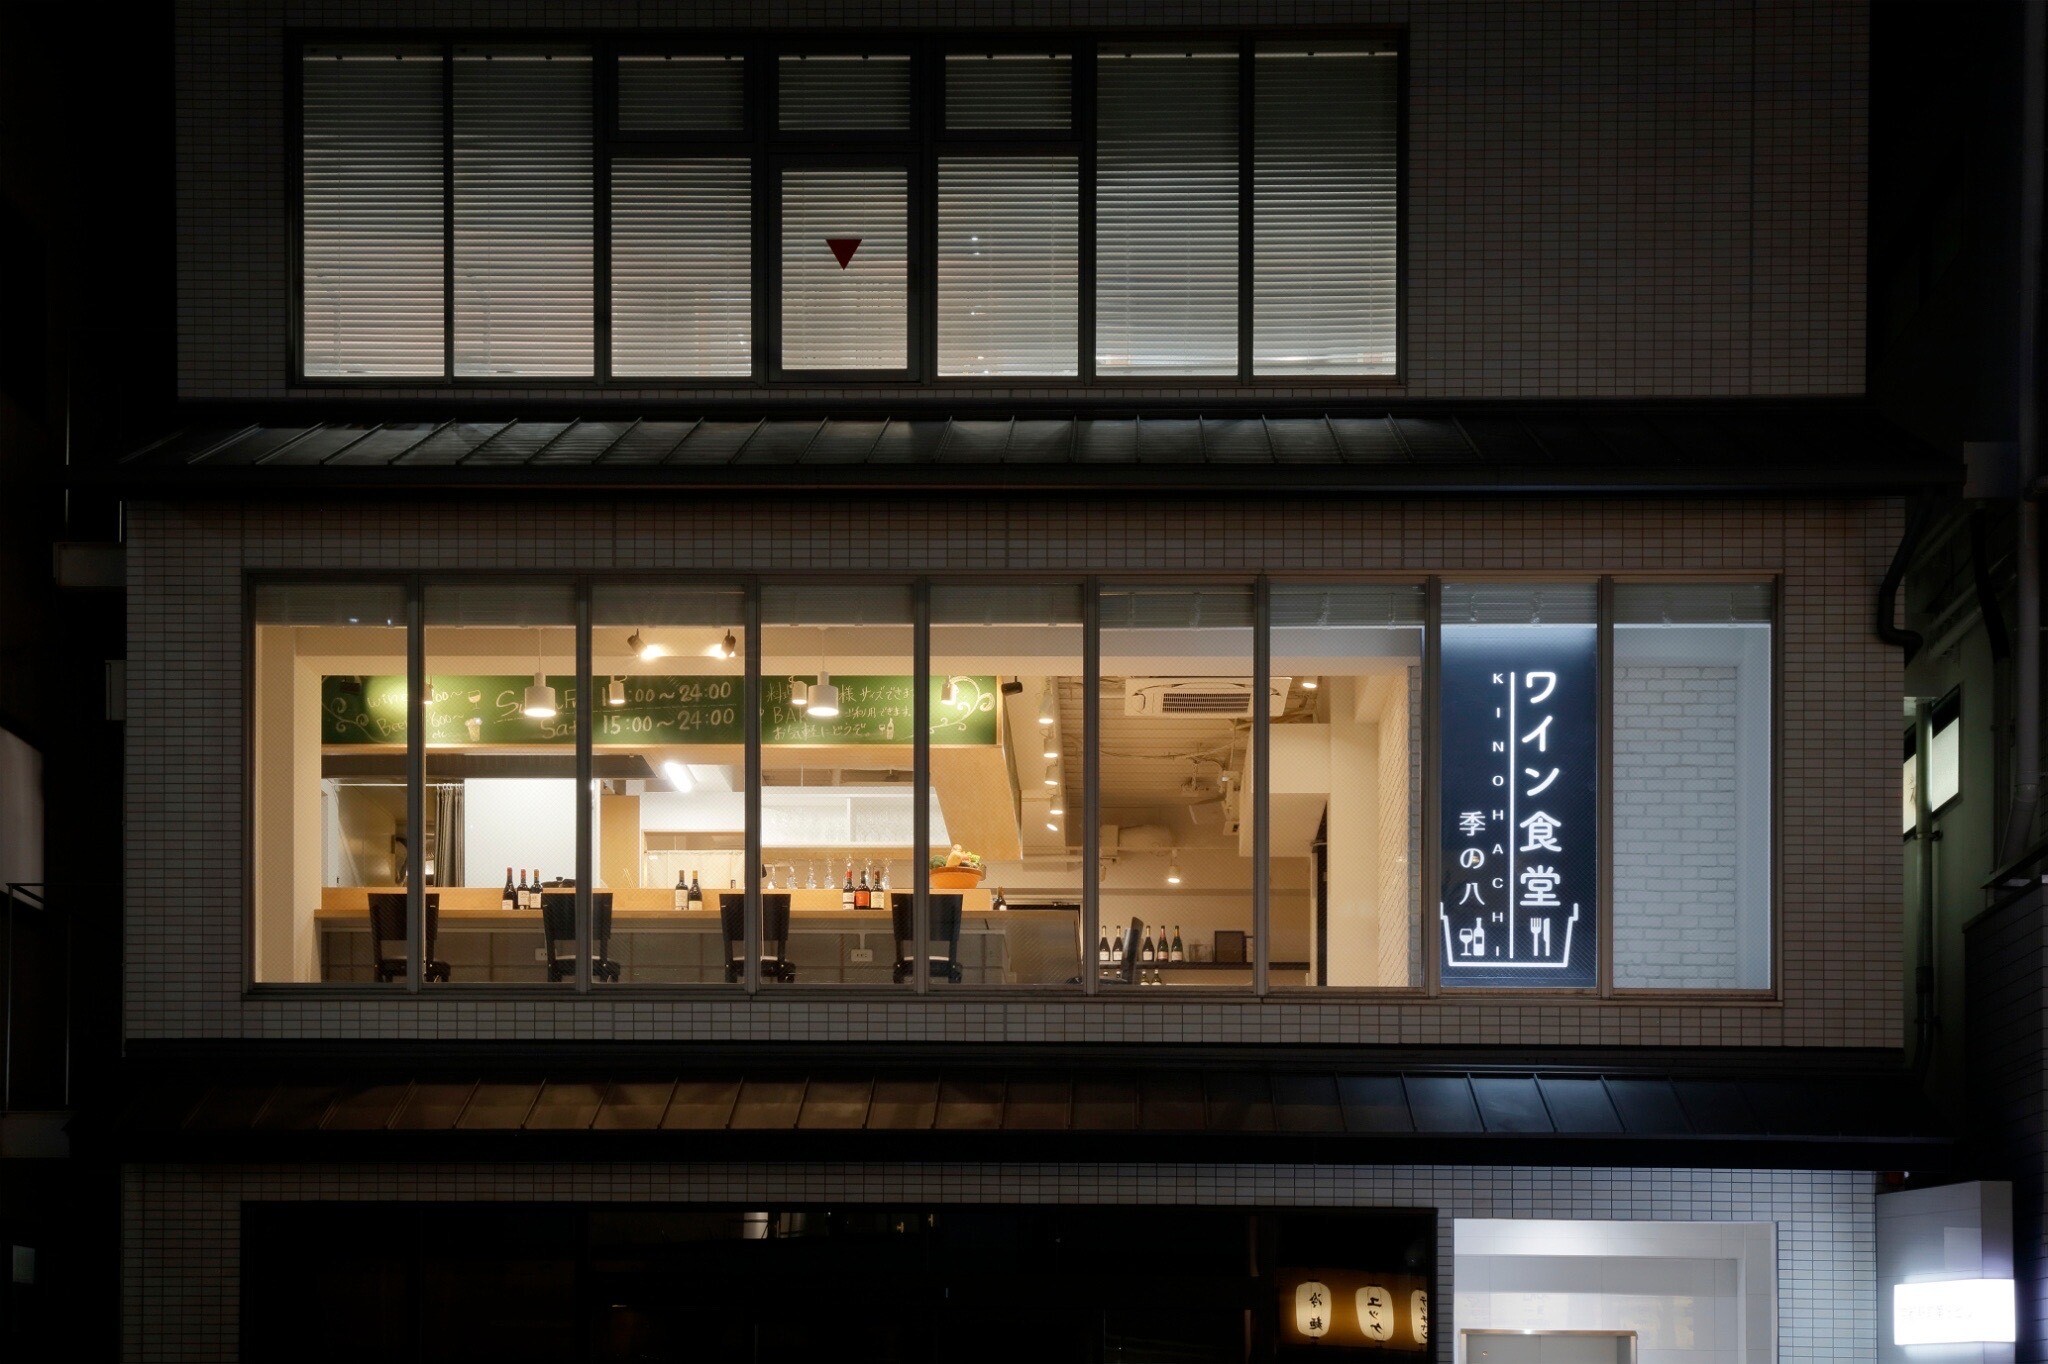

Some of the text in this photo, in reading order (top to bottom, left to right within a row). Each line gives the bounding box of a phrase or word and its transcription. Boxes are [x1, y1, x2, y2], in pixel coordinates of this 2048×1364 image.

[1459, 811, 1486, 906] 季の八
[1492, 673, 1504, 957] KINOHACHI
[1519, 671, 1563, 907] ワイン食堂
